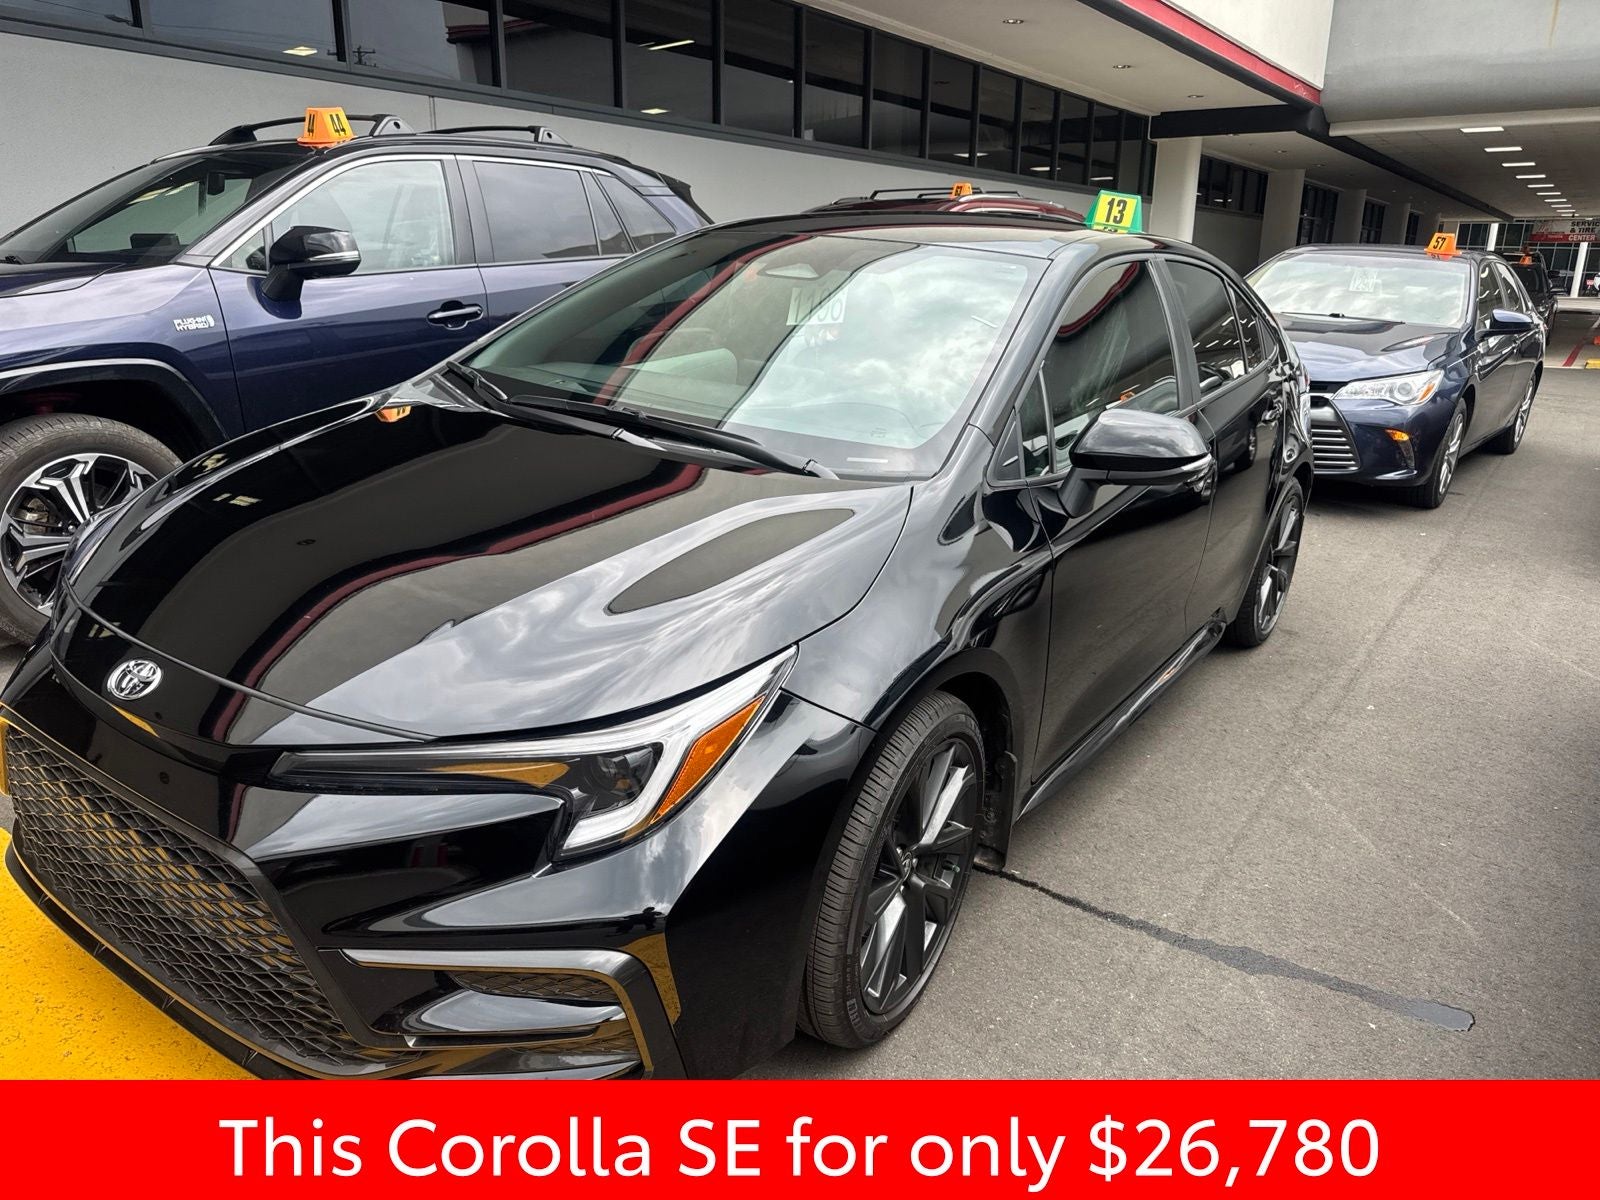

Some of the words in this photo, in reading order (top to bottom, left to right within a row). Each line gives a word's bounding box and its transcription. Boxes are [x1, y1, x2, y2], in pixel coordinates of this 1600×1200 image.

[329, 113, 347, 137] 44
[1104, 197, 1128, 225] 13
[1432, 236, 1446, 250] 57
